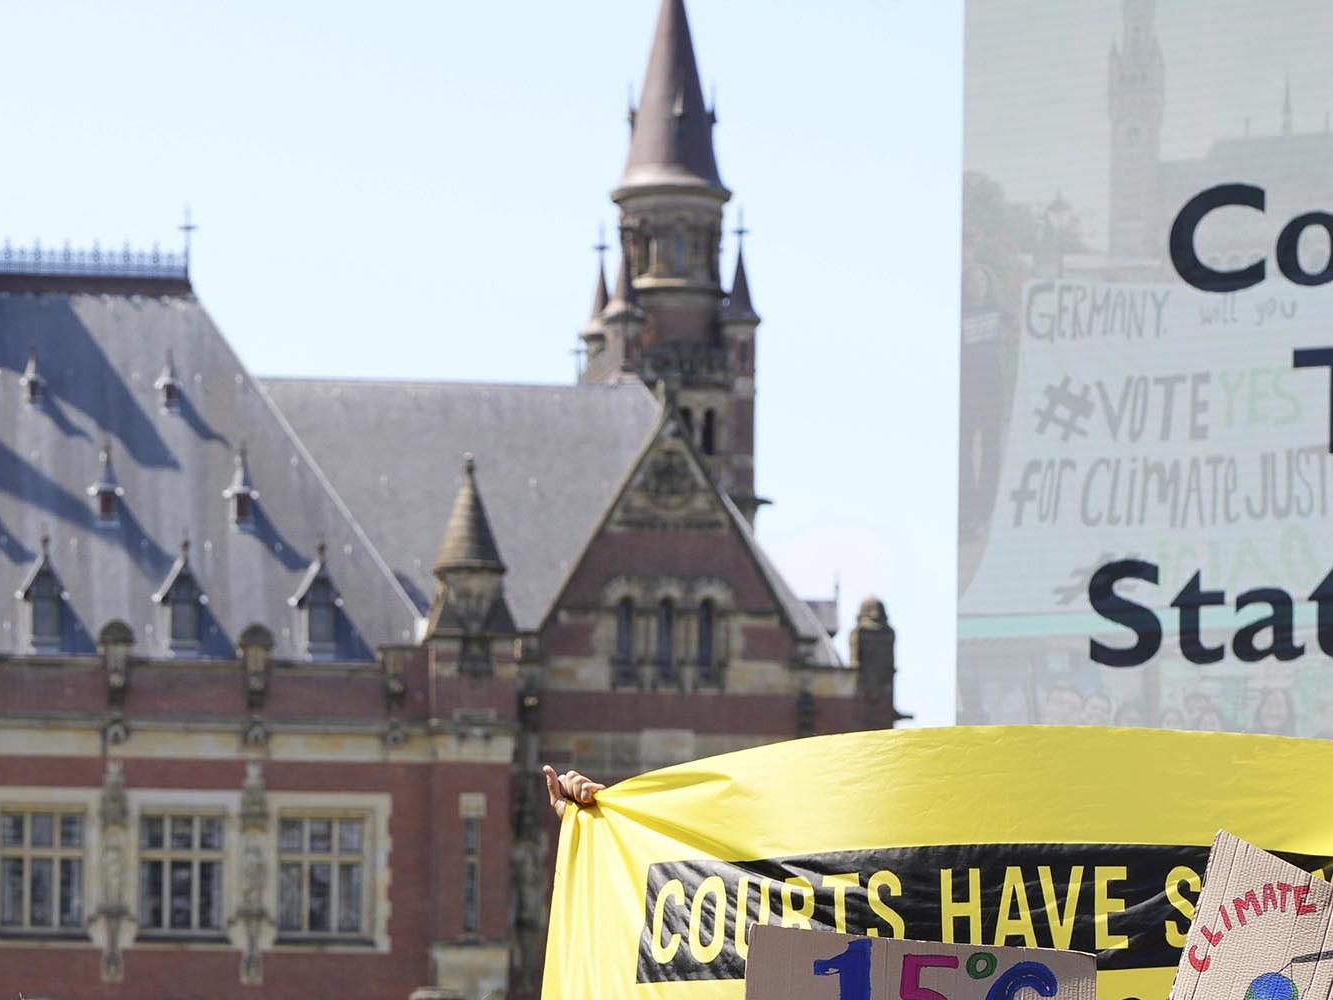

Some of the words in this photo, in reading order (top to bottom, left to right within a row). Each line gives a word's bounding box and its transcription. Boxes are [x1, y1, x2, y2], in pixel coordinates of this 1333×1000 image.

[1034, 370, 1211, 443] #VOTE
[1220, 366, 1302, 427] YES
[651, 870, 905, 964] COURTS
[940, 866, 1128, 950] HAVE
[1189, 883, 1316, 973] CLIMATE
